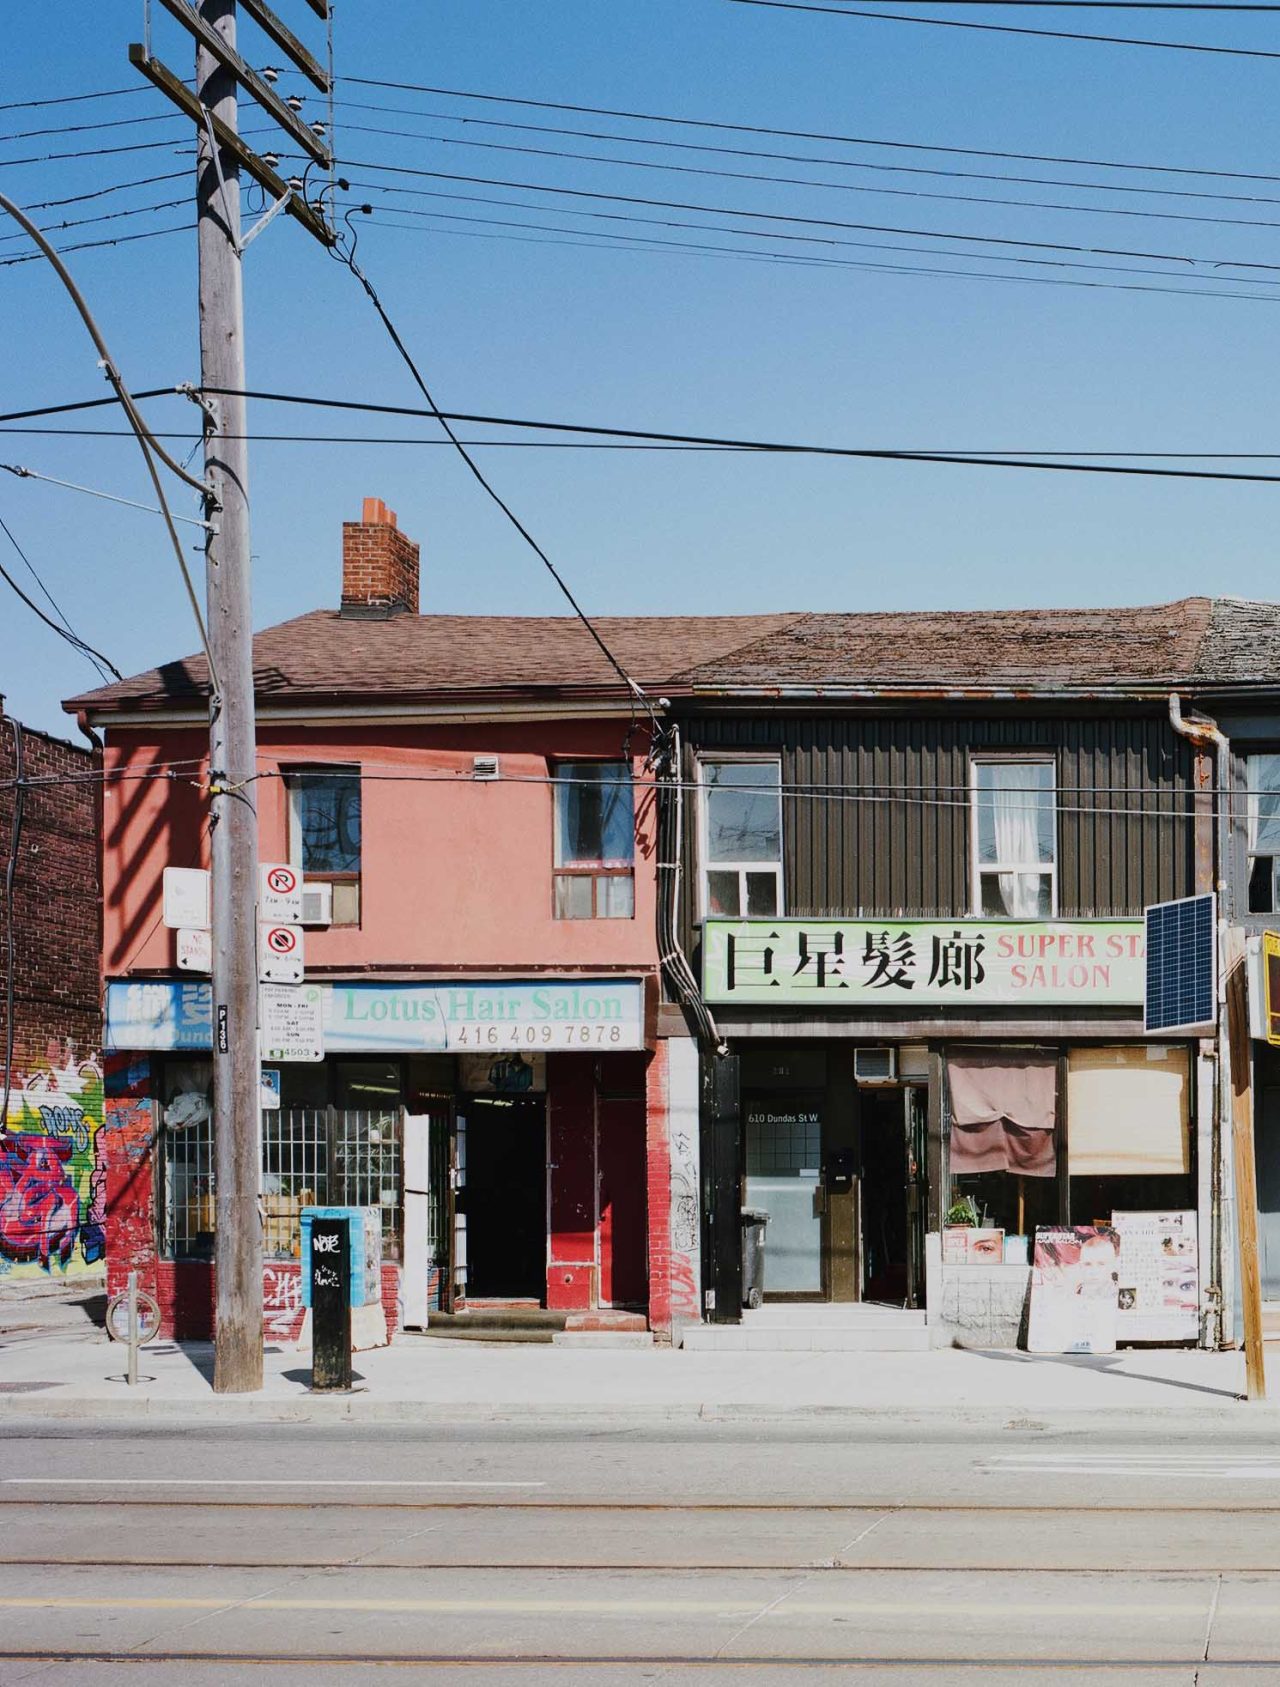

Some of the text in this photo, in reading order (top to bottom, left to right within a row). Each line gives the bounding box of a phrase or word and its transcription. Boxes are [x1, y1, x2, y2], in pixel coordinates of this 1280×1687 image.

[997, 933, 1095, 959] SUPER
[726, 930, 987, 991] 巨星髮廊
[1010, 963, 1111, 989] SALON
[344, 988, 623, 1021] Lotus Hair Salon
[458, 1025, 621, 1044] 416 409 7878
[284, 1048, 310, 1057] 4503
[748, 1113, 818, 1123] 610 Dundas St W
